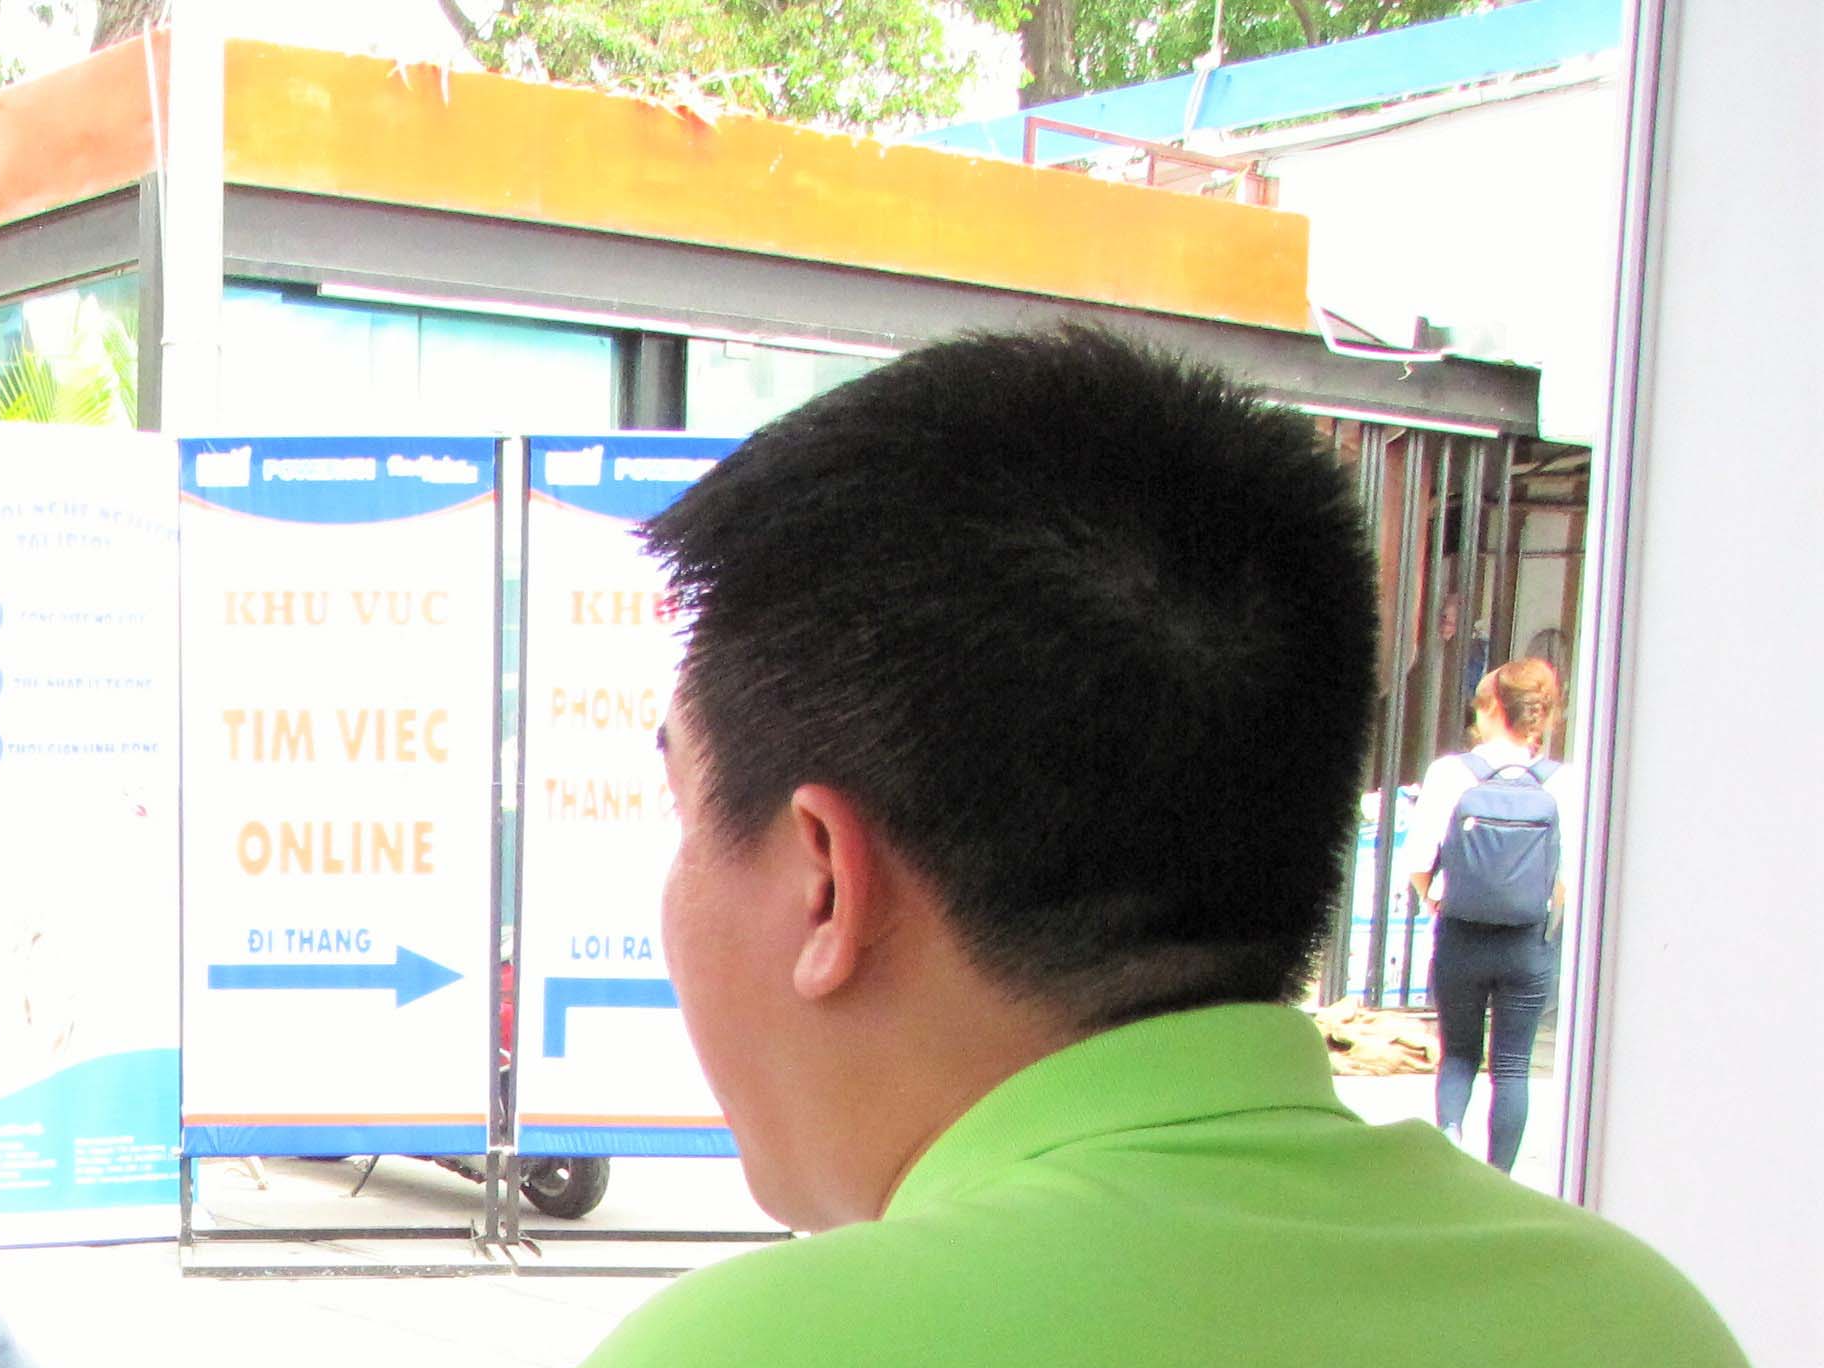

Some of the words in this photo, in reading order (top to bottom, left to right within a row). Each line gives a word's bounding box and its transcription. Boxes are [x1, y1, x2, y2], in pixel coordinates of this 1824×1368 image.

[224, 590, 331, 626] KHU
[236, 819, 437, 877] ONLINE
[623, 936, 653, 961] RA
